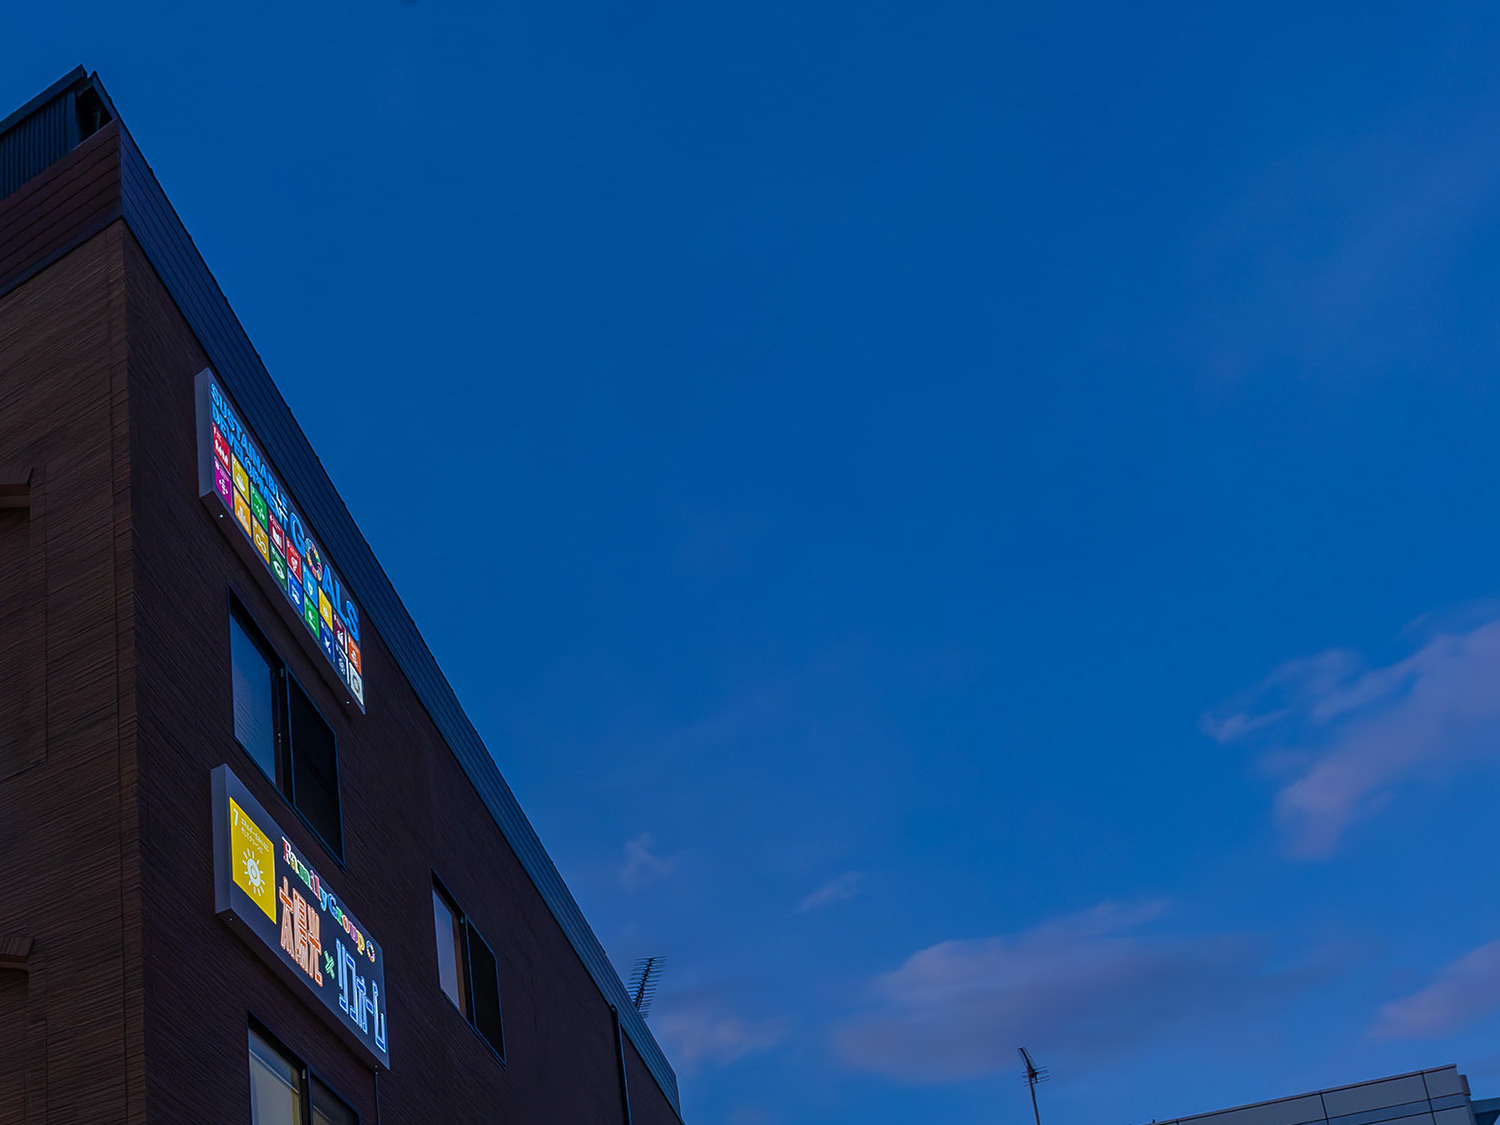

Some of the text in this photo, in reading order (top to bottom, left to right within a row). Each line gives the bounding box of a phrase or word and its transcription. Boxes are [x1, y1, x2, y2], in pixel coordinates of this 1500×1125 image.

[210, 383, 288, 511] SUSTAINABLE
[211, 401, 288, 531] DEVELOPMENT
[289, 512, 360, 642] GOALS
